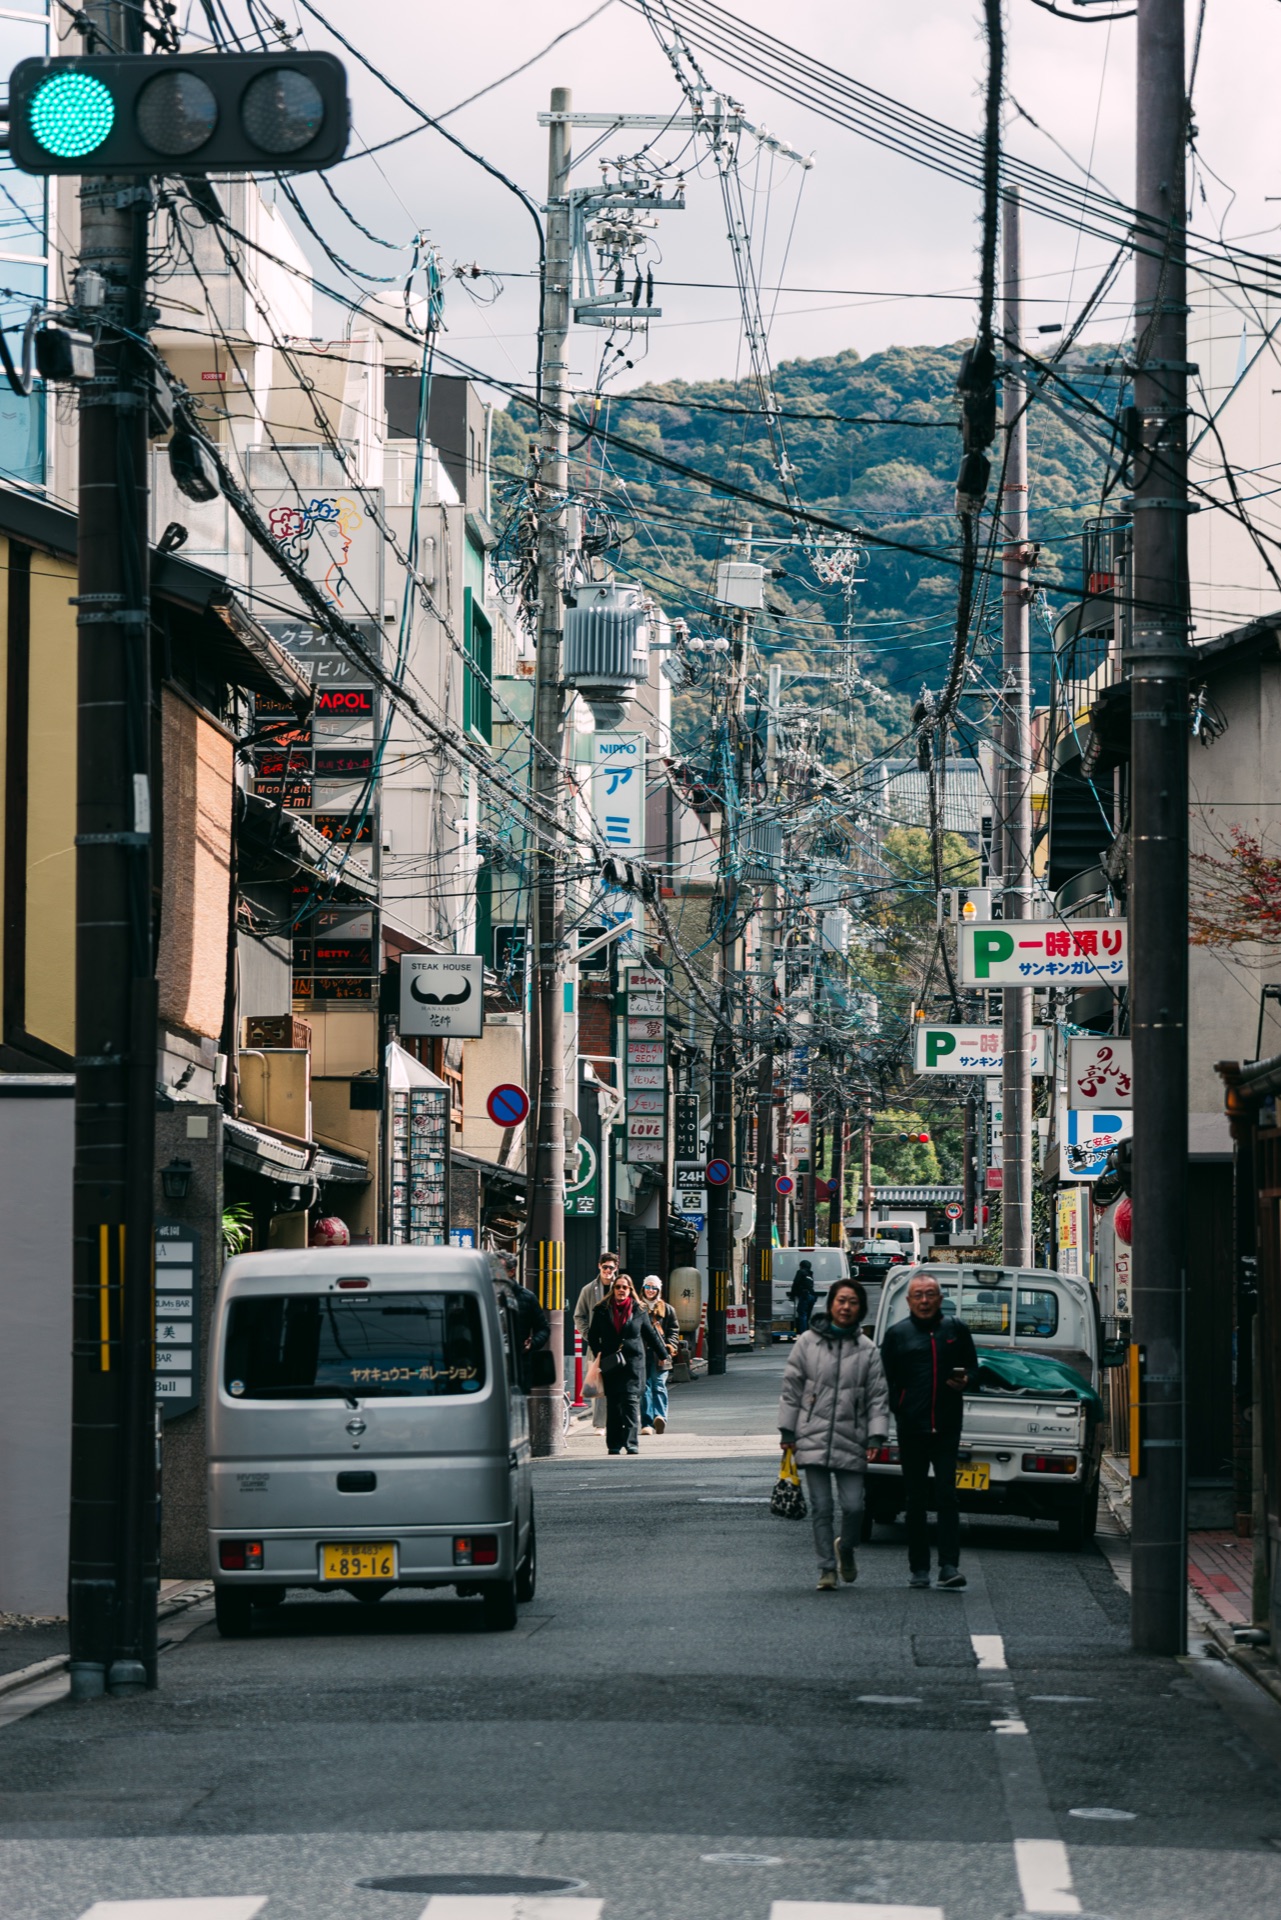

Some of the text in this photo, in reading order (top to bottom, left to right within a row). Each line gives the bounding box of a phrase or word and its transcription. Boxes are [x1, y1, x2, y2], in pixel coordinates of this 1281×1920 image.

[319, 693, 370, 709] APOL
[319, 722, 340, 734] 5F
[600, 744, 637, 754] NIPPO
[318, 912, 339, 924] 2F
[349, 923, 369, 935] 1F
[1018, 929, 1123, 957] 一時預り
[316, 949, 350, 958] BETTY
[973, 930, 1014, 978] P
[411, 963, 472, 971] STEAK HOUSE
[1018, 960, 1124, 976] サンキンガレージ
[644, 1020, 663, 1037] 夢
[925, 1031, 956, 1067] P
[631, 1124, 660, 1135] LOVE
[678, 1171, 705, 1182] 24H
[576, 1195, 595, 1214] 空
[175, 1300, 190, 1308] BAR
[339, 1557, 391, 1576] 89-16
